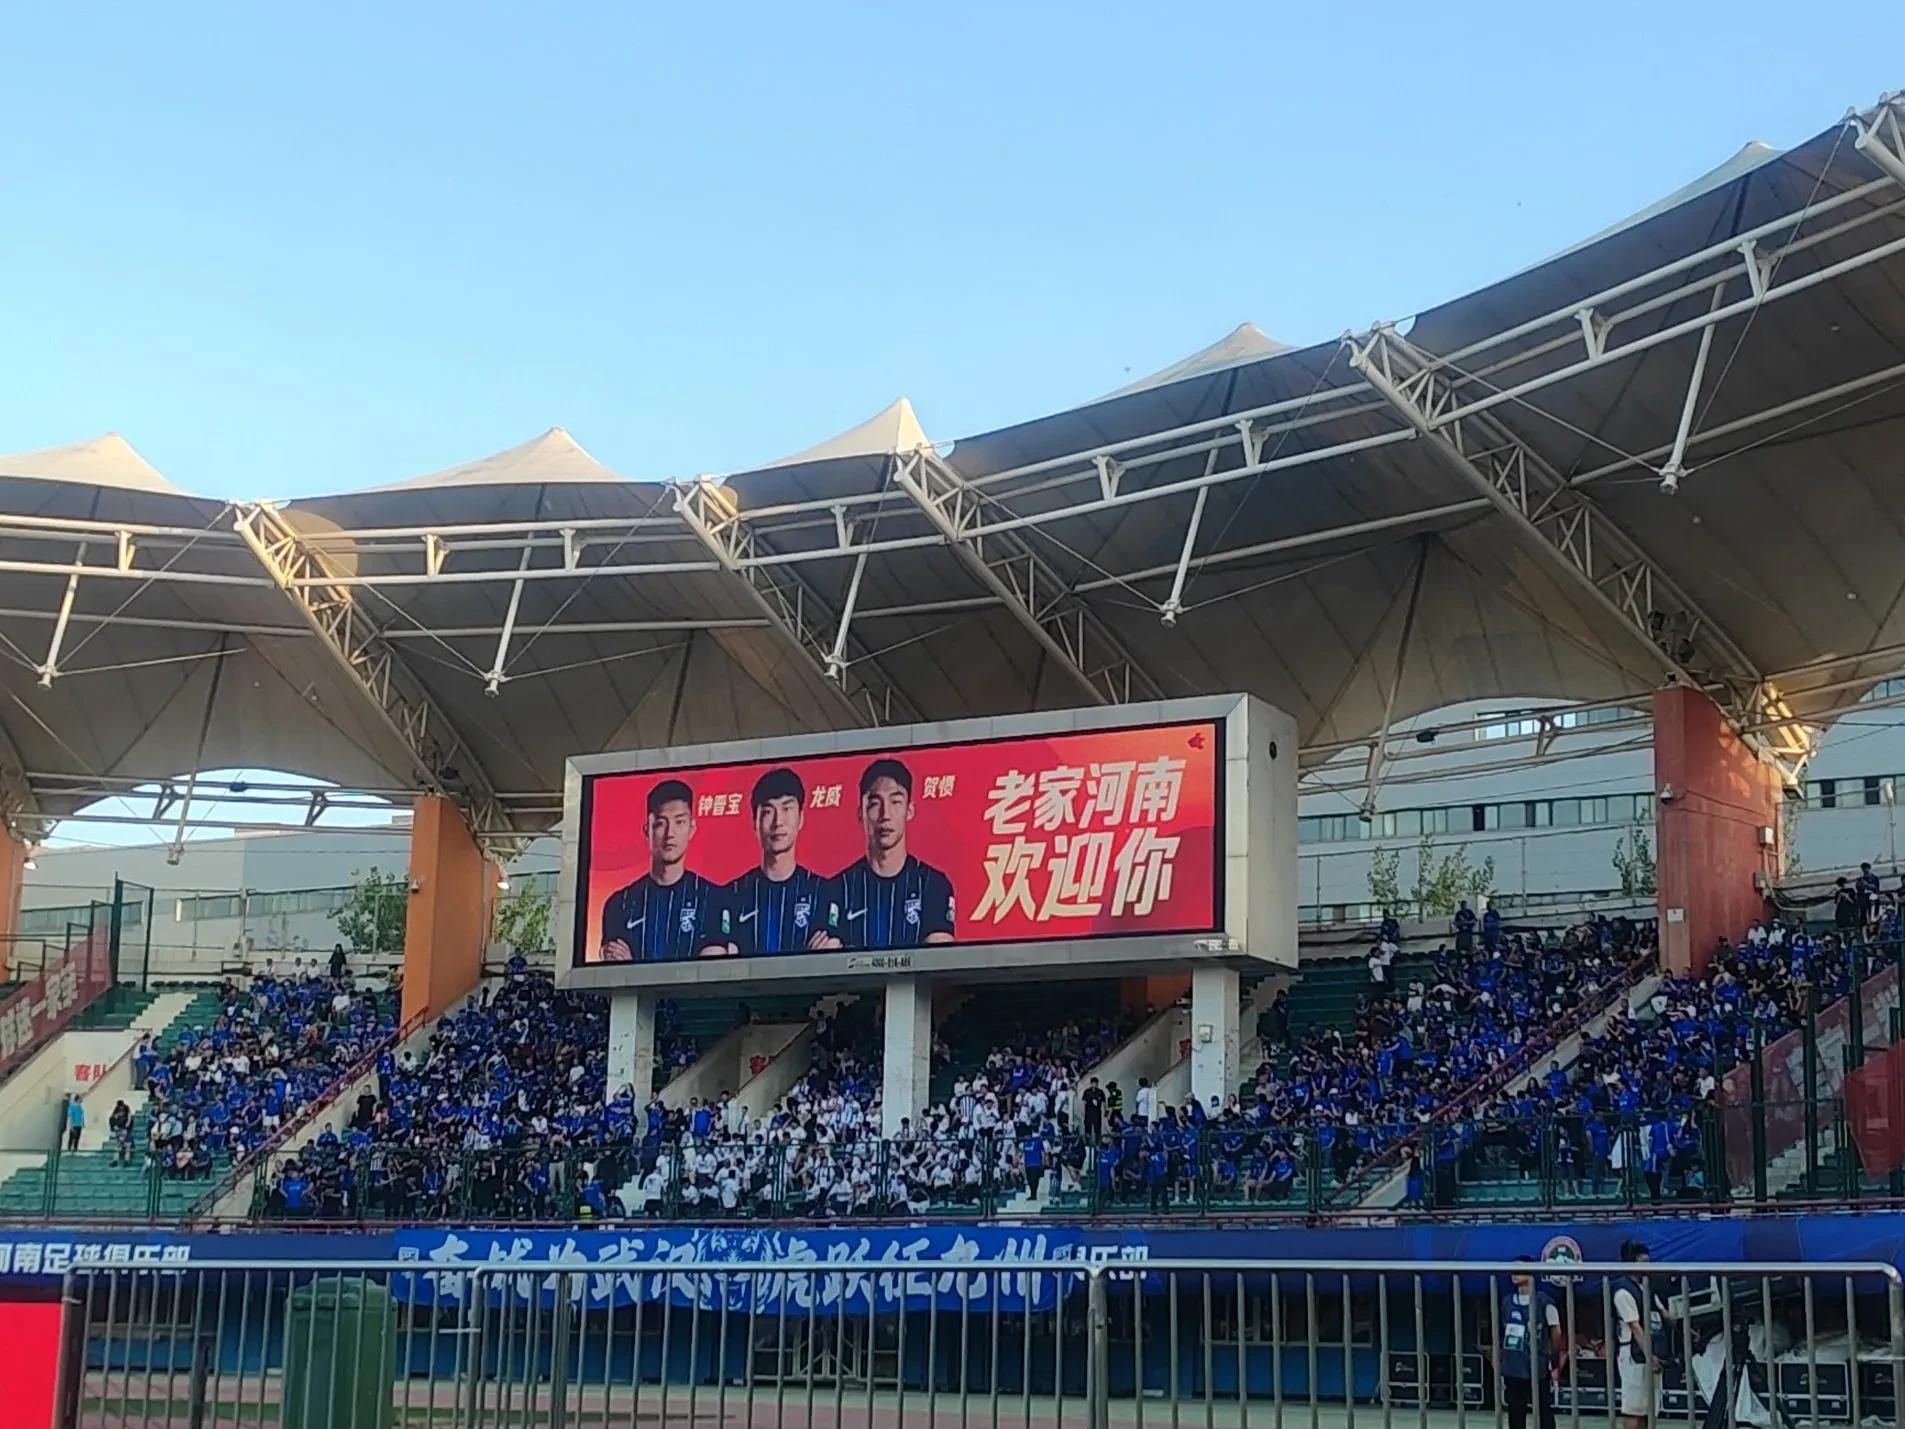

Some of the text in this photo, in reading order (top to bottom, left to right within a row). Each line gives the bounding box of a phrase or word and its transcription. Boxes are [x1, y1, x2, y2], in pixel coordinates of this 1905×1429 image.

[698, 794, 743, 816] 钟晋宝
[810, 785, 842, 808] 龙威
[984, 756, 1186, 834] 老家河南
[969, 827, 1180, 924] 欢迎你
